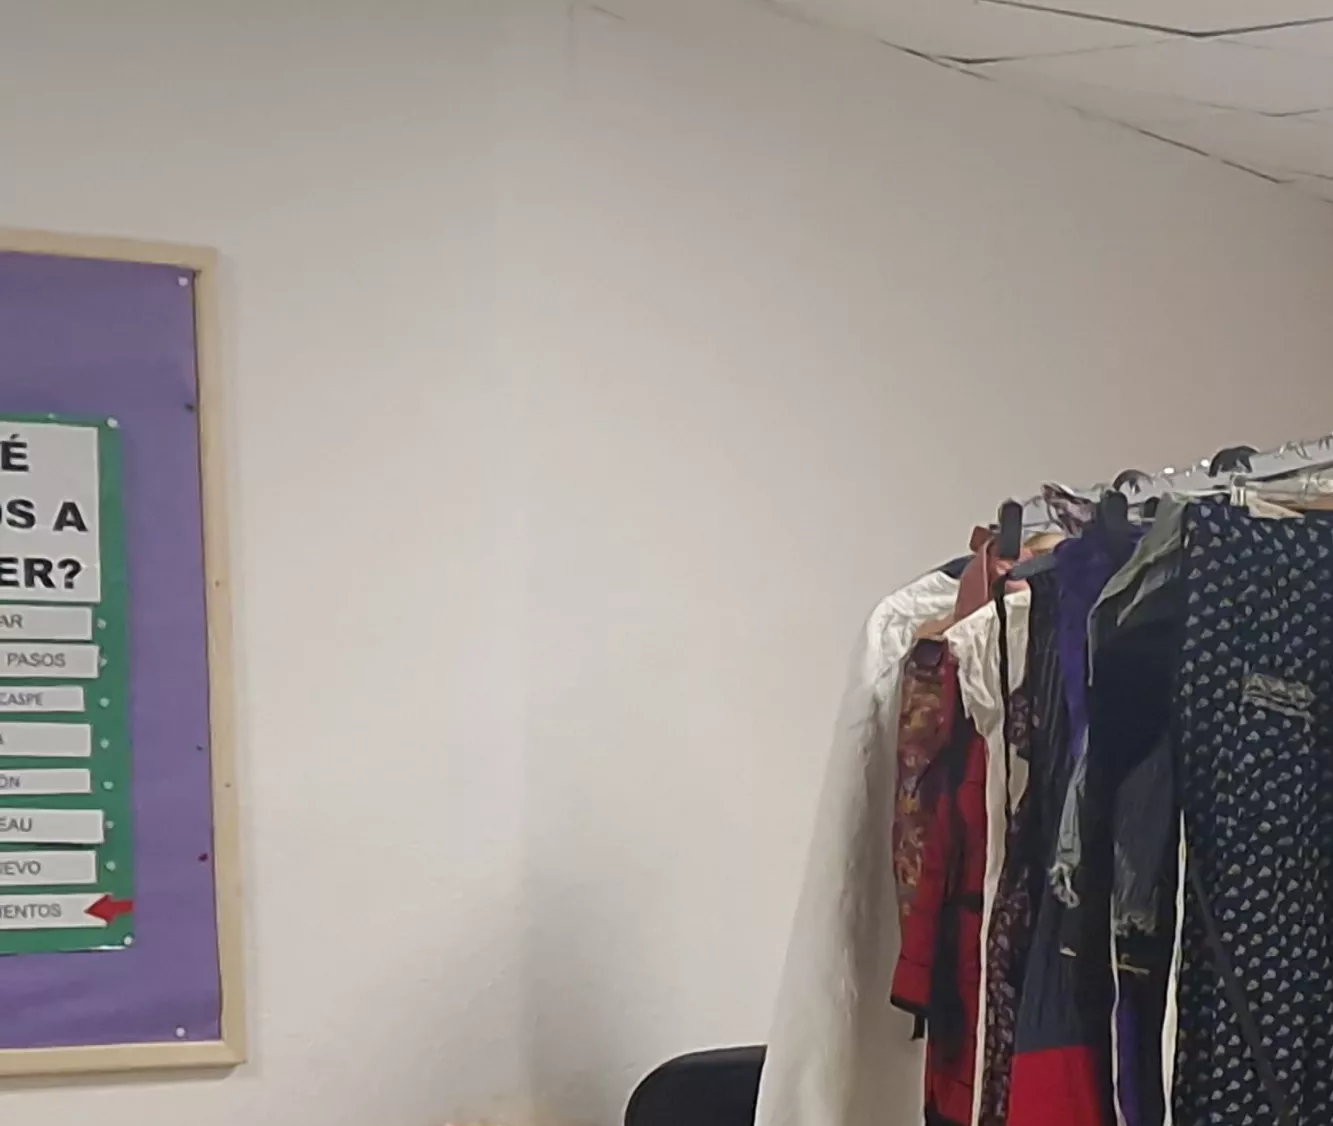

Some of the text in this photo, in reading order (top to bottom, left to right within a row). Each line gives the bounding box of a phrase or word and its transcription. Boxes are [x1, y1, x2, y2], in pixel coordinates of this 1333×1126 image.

[0, 499, 88, 532] S A
[7, 652, 66, 667] PASOS
[0, 860, 41, 876] EVO
